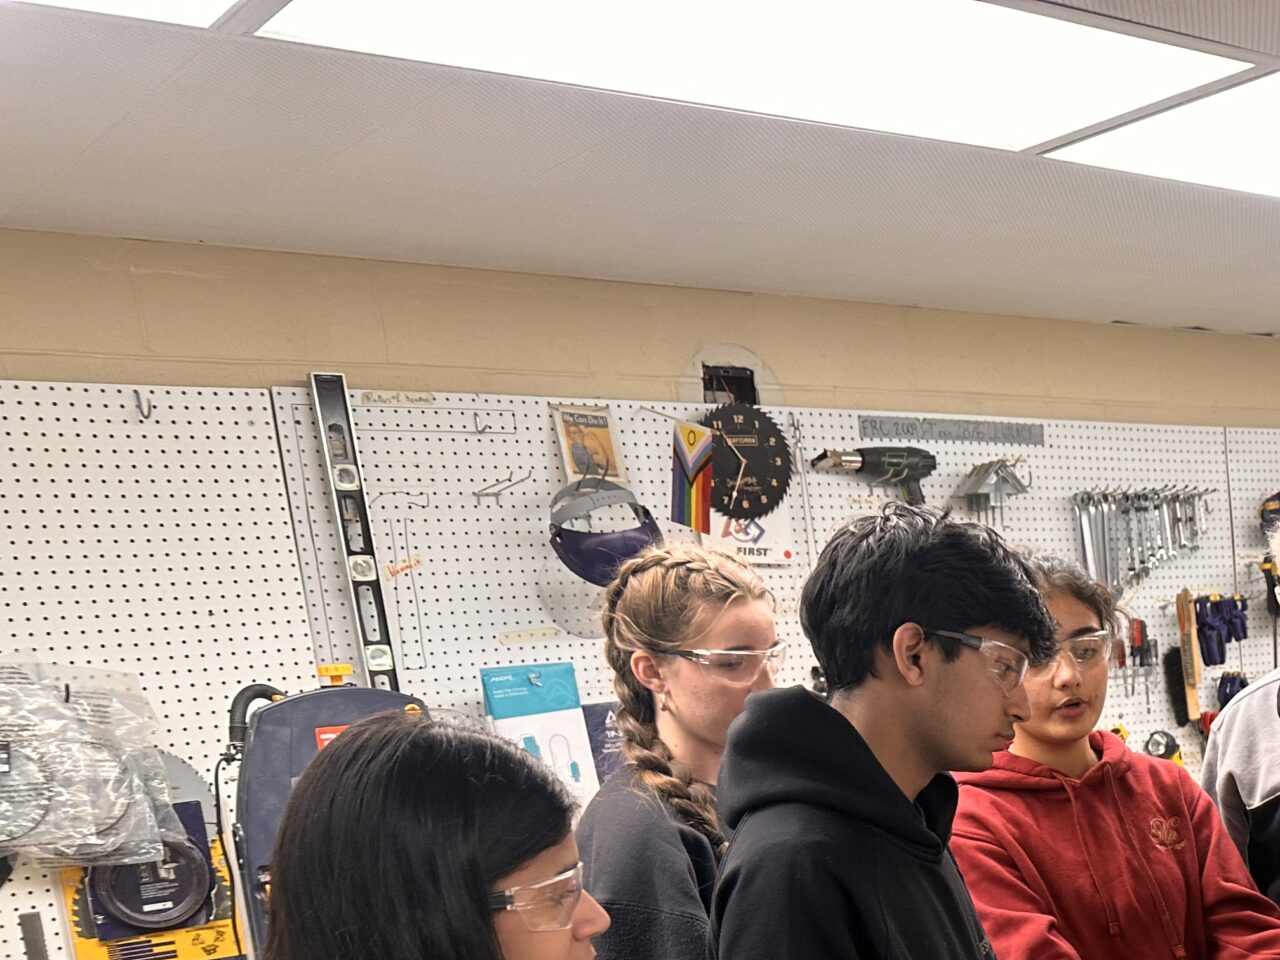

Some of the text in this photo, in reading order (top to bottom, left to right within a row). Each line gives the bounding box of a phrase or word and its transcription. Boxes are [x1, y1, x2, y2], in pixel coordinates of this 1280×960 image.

[733, 414, 744, 423] 12
[712, 420, 722, 429] 11
[861, 418, 889, 437] FRC
[768, 437, 776, 446] 2
[774, 457, 782, 466] 3
[771, 478, 778, 487] 4
[722, 496, 729, 505] 7
[760, 495, 768, 504] 5
[741, 500, 749, 509] 6
[736, 547, 769, 556] FIRST
